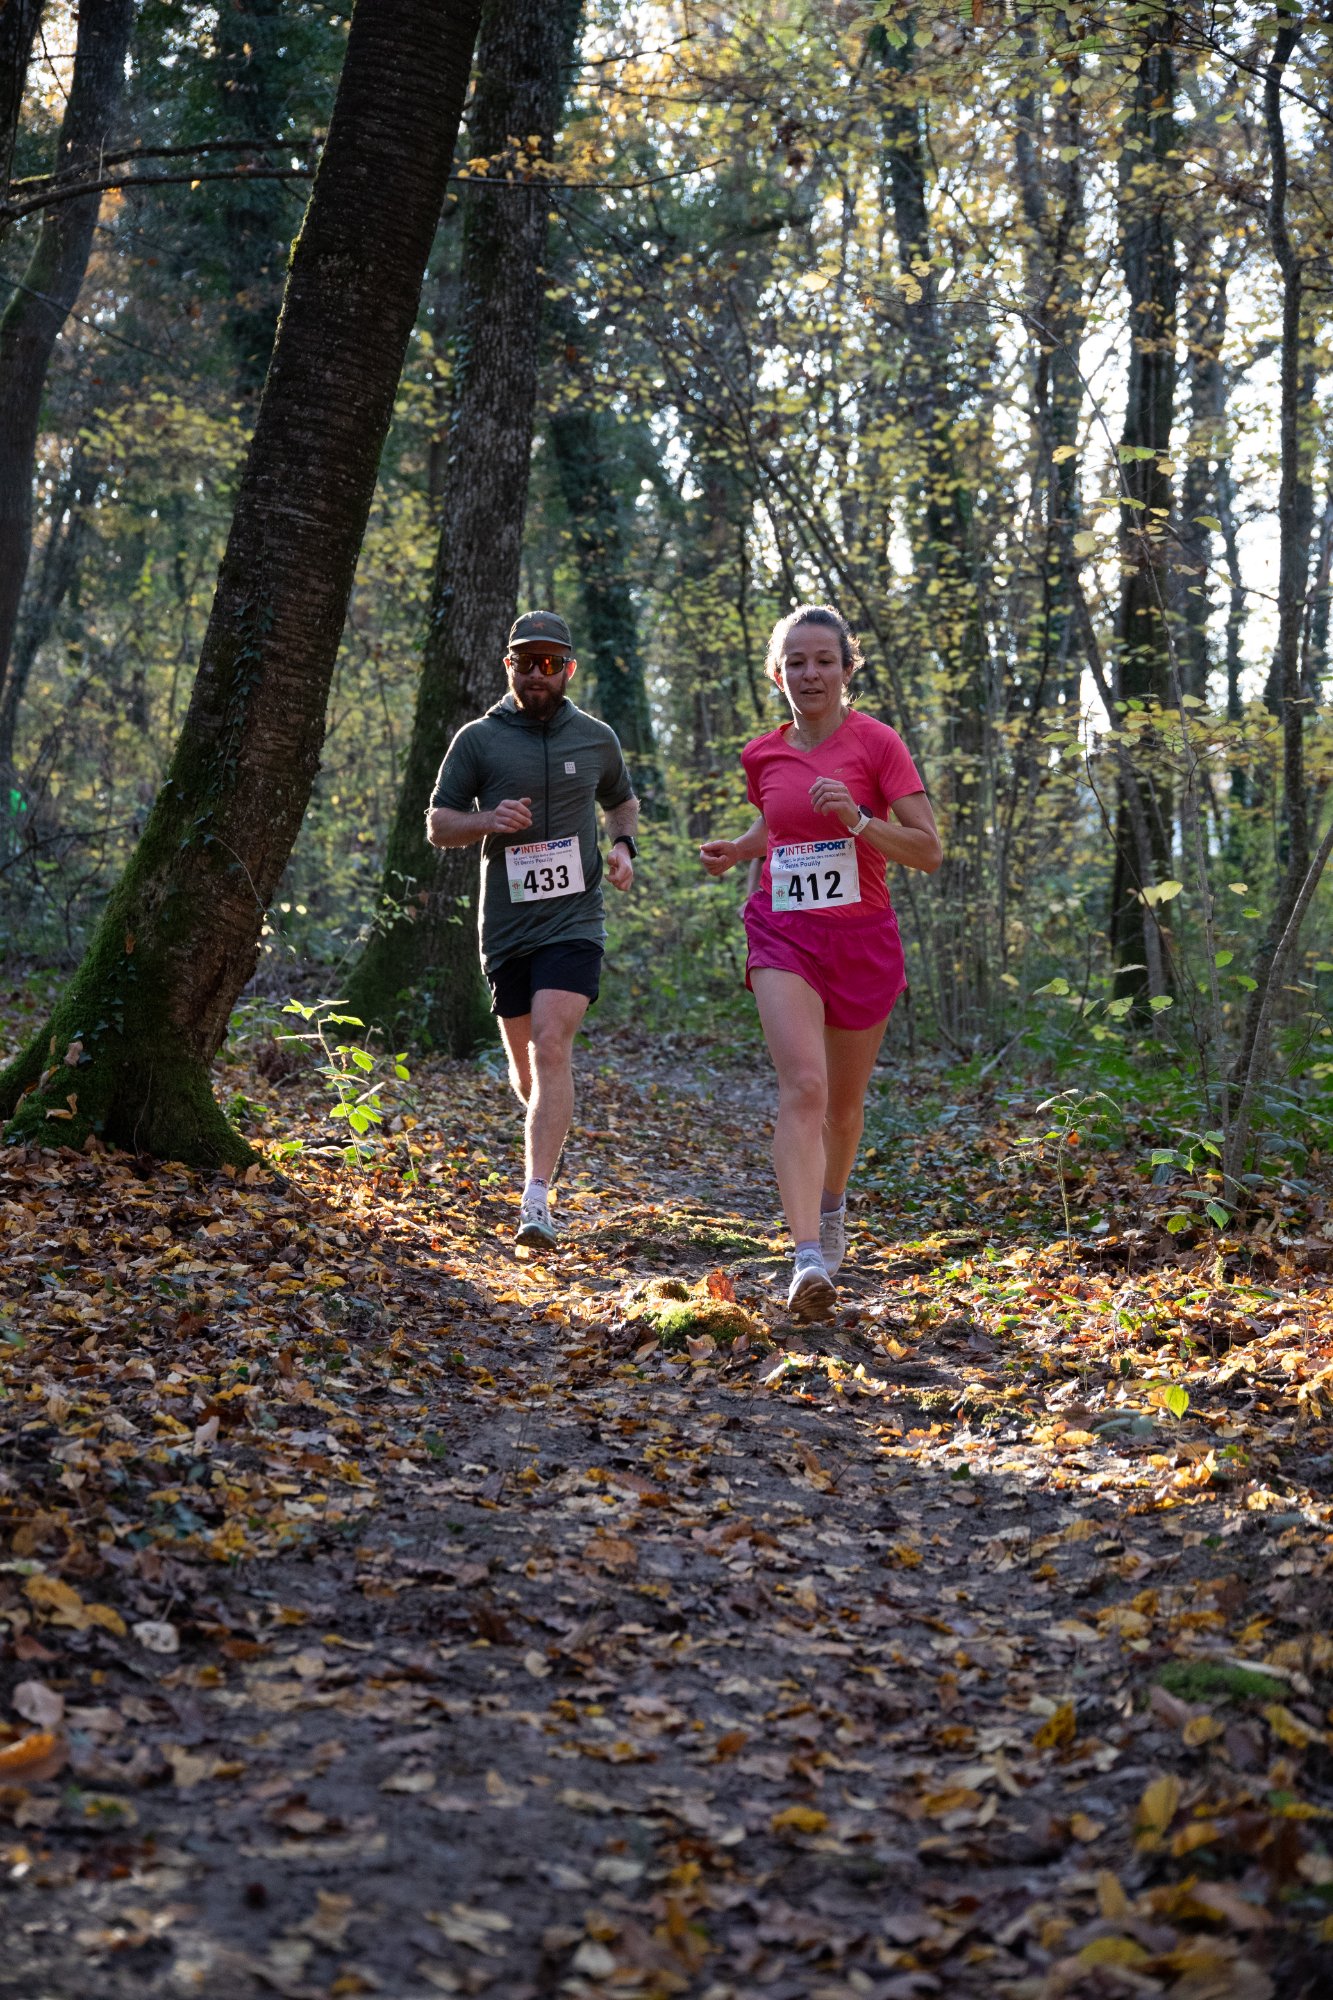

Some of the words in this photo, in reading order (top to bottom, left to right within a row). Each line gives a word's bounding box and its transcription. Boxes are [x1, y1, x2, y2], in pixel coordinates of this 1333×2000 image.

[521, 839, 572, 854] INTERSPORT
[785, 840, 846, 856] INTERSPORT
[524, 865, 570, 894] 433
[788, 870, 843, 902] 412
